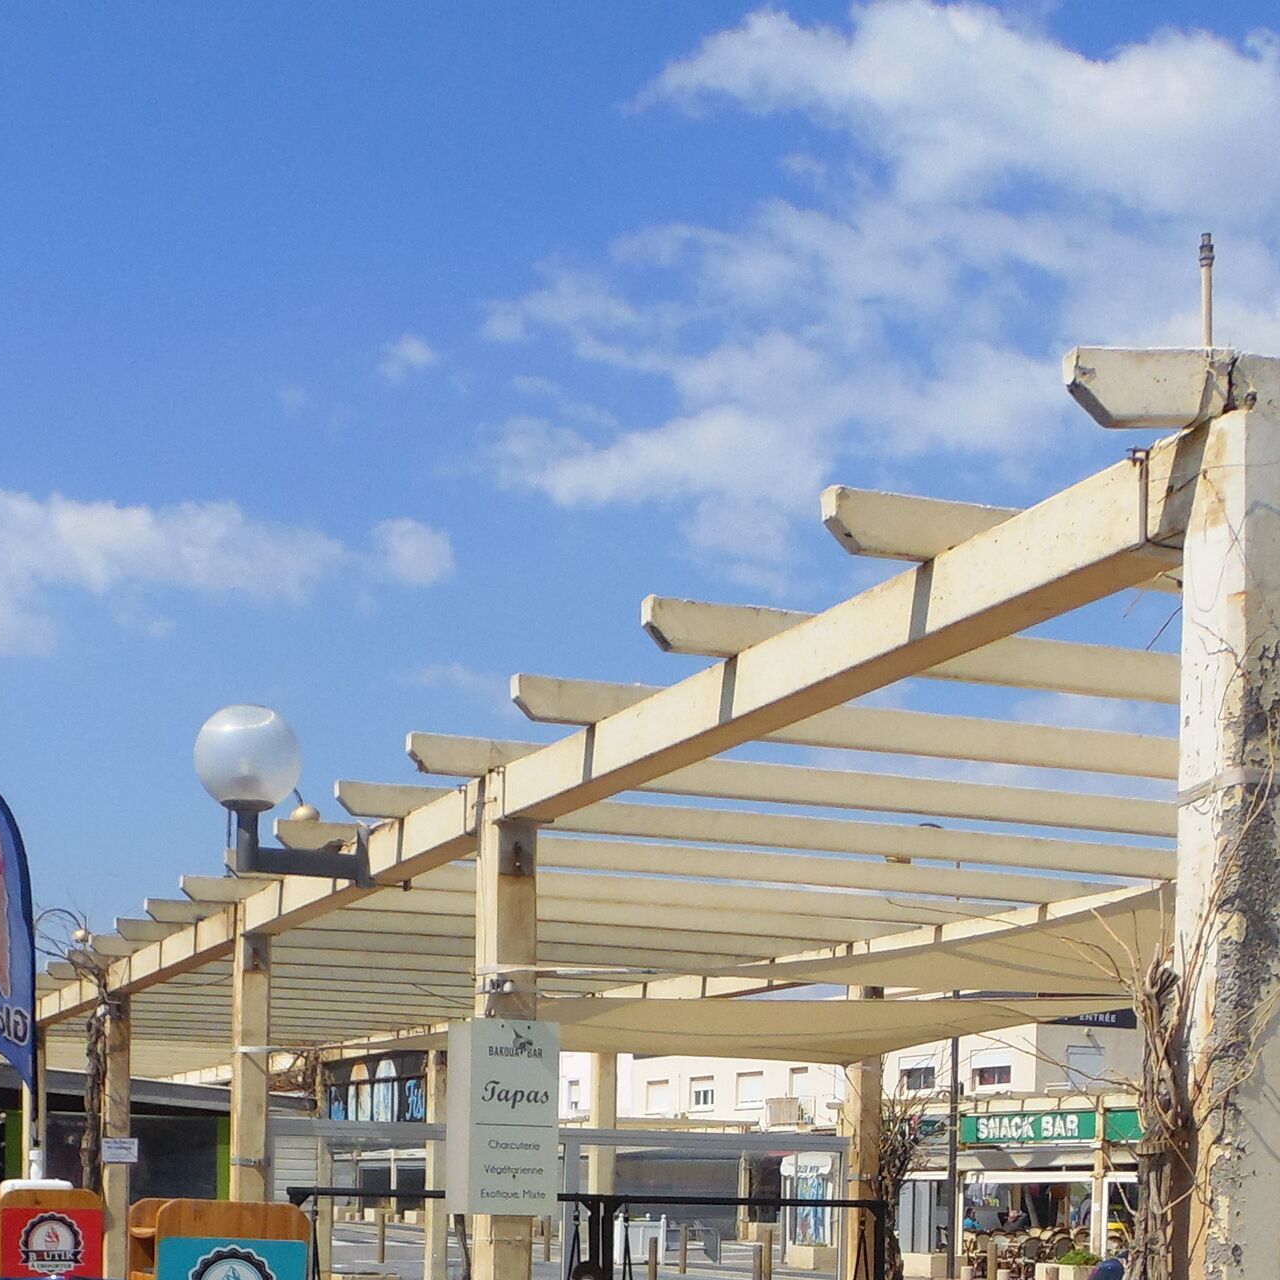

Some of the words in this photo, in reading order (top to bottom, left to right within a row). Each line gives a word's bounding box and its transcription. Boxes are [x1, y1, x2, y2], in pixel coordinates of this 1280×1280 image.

[1079, 1012, 1117, 1023] ENTRÉE
[527, 1048, 543, 1058] BAR
[481, 1080, 550, 1109] Tapas
[977, 1115, 1035, 1139] SNACK
[1040, 1114, 1080, 1138] BAR
[488, 1139, 541, 1151] Charcuterie
[483, 1163, 544, 1175] Végétarienne
[522, 1189, 547, 1199] Mixte
